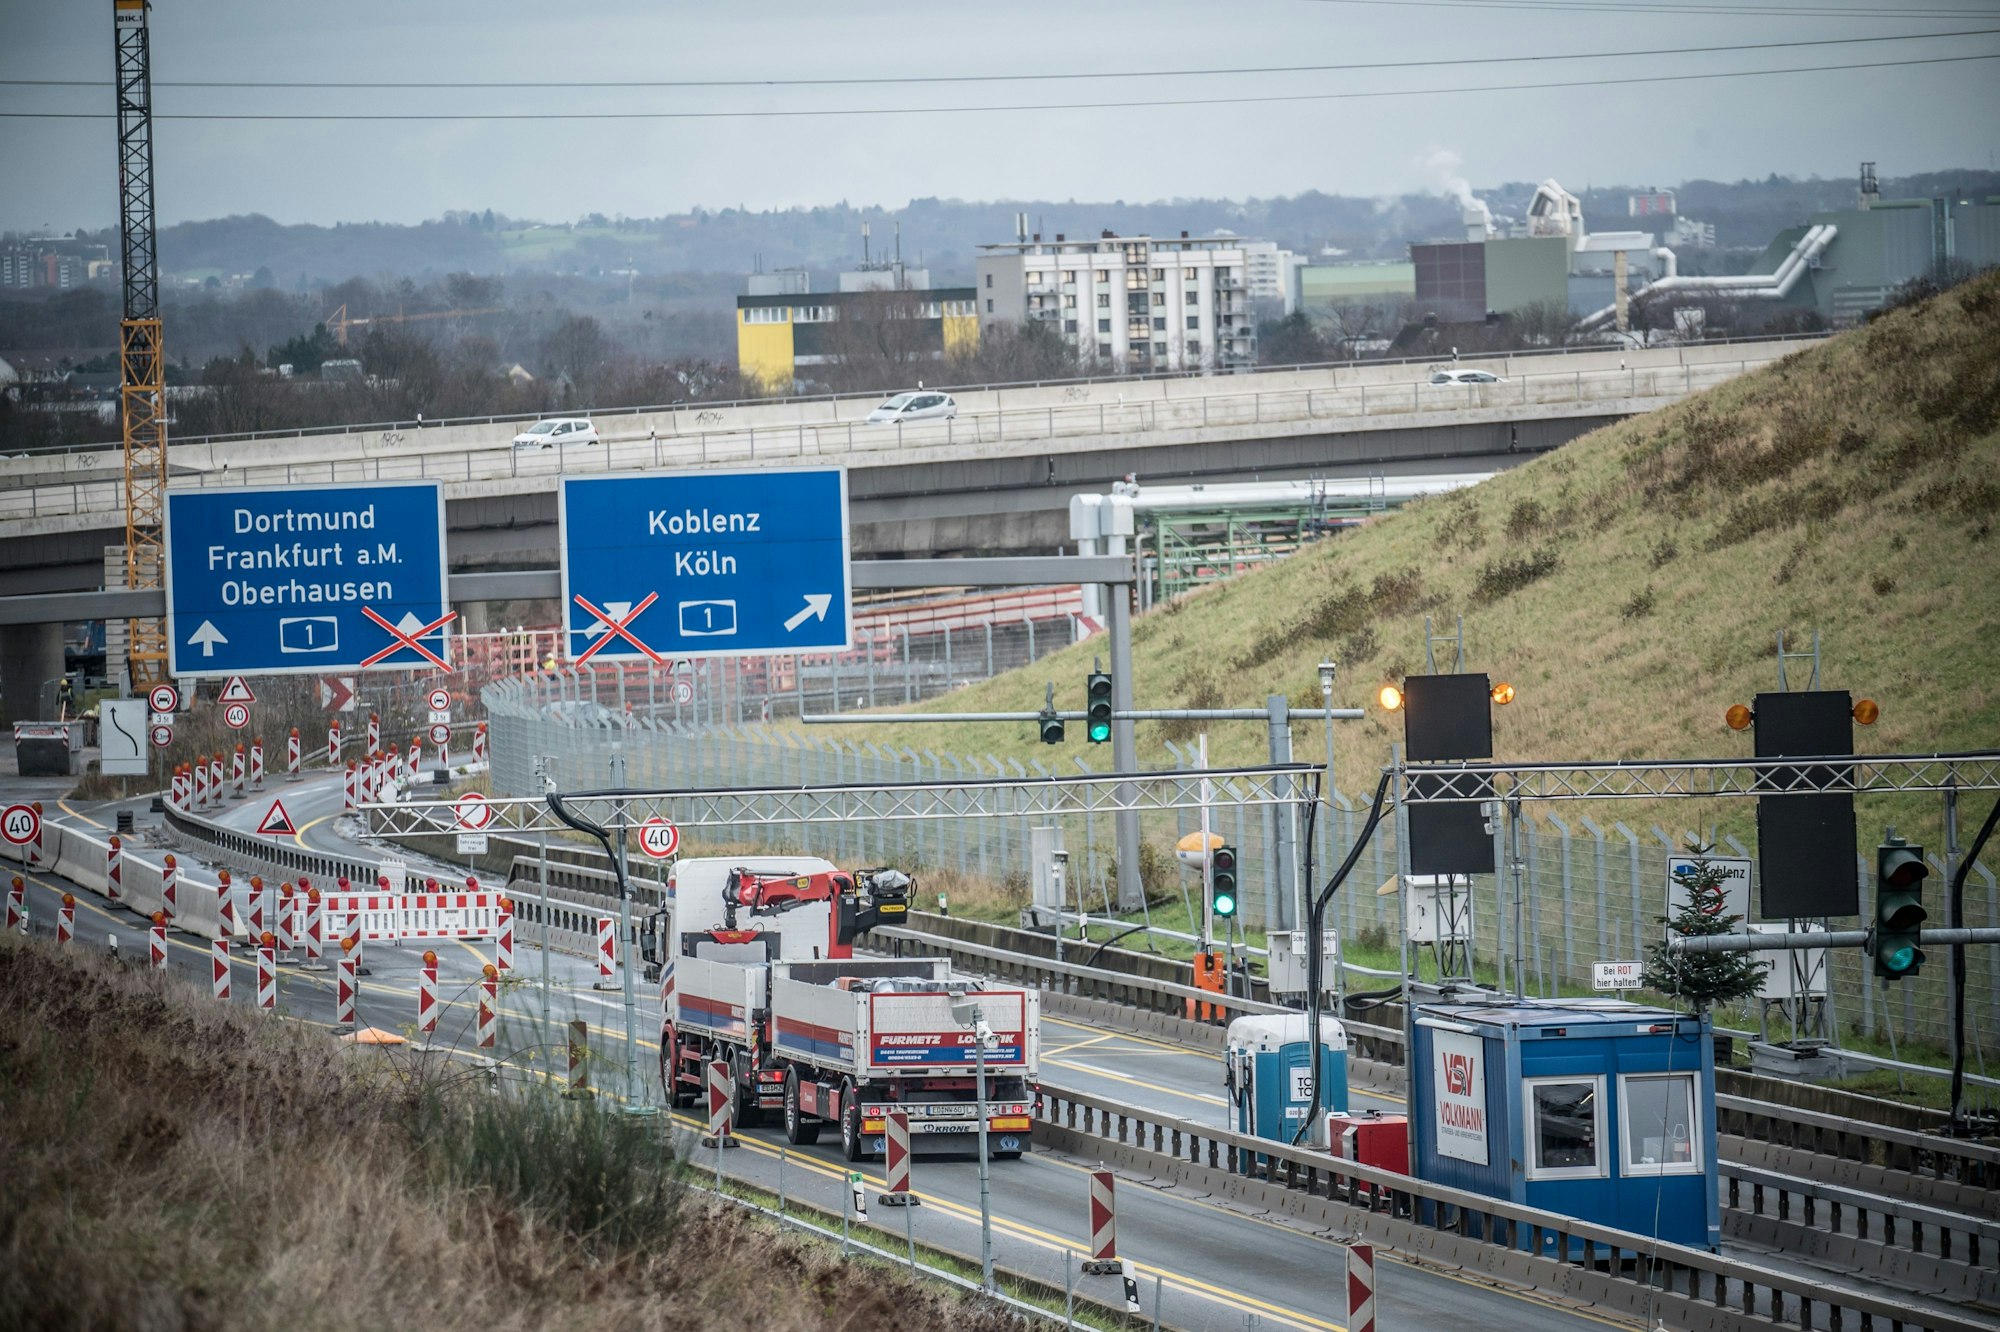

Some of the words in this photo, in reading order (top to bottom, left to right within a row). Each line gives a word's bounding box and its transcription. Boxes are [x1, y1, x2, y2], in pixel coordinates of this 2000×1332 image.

[379, 432, 406, 448] 1904
[75, 455, 100, 470] 1904
[234, 504, 375, 534] Dortmund
[649, 508, 761, 535] Koblenz
[208, 543, 343, 571] Frankfurt
[357, 542, 403, 565] a.M.
[675, 550, 737, 576] Köln
[221, 579, 393, 606] Oberhausen
[704, 607, 712, 629] 1
[305, 624, 313, 646] 1
[229, 709, 244, 721] 40
[9, 815, 31, 833] 40
[648, 829, 670, 847] 40
[1603, 965, 1616, 976] Bei
[1617, 965, 1632, 975] ROT
[1596, 978, 1611, 987] hier
[1613, 977, 1641, 987] halten!
[880, 1035, 941, 1045] FURMETZ
[1440, 1101, 1482, 1132] VOLKMANN
[936, 1125, 970, 1133] KRONE
